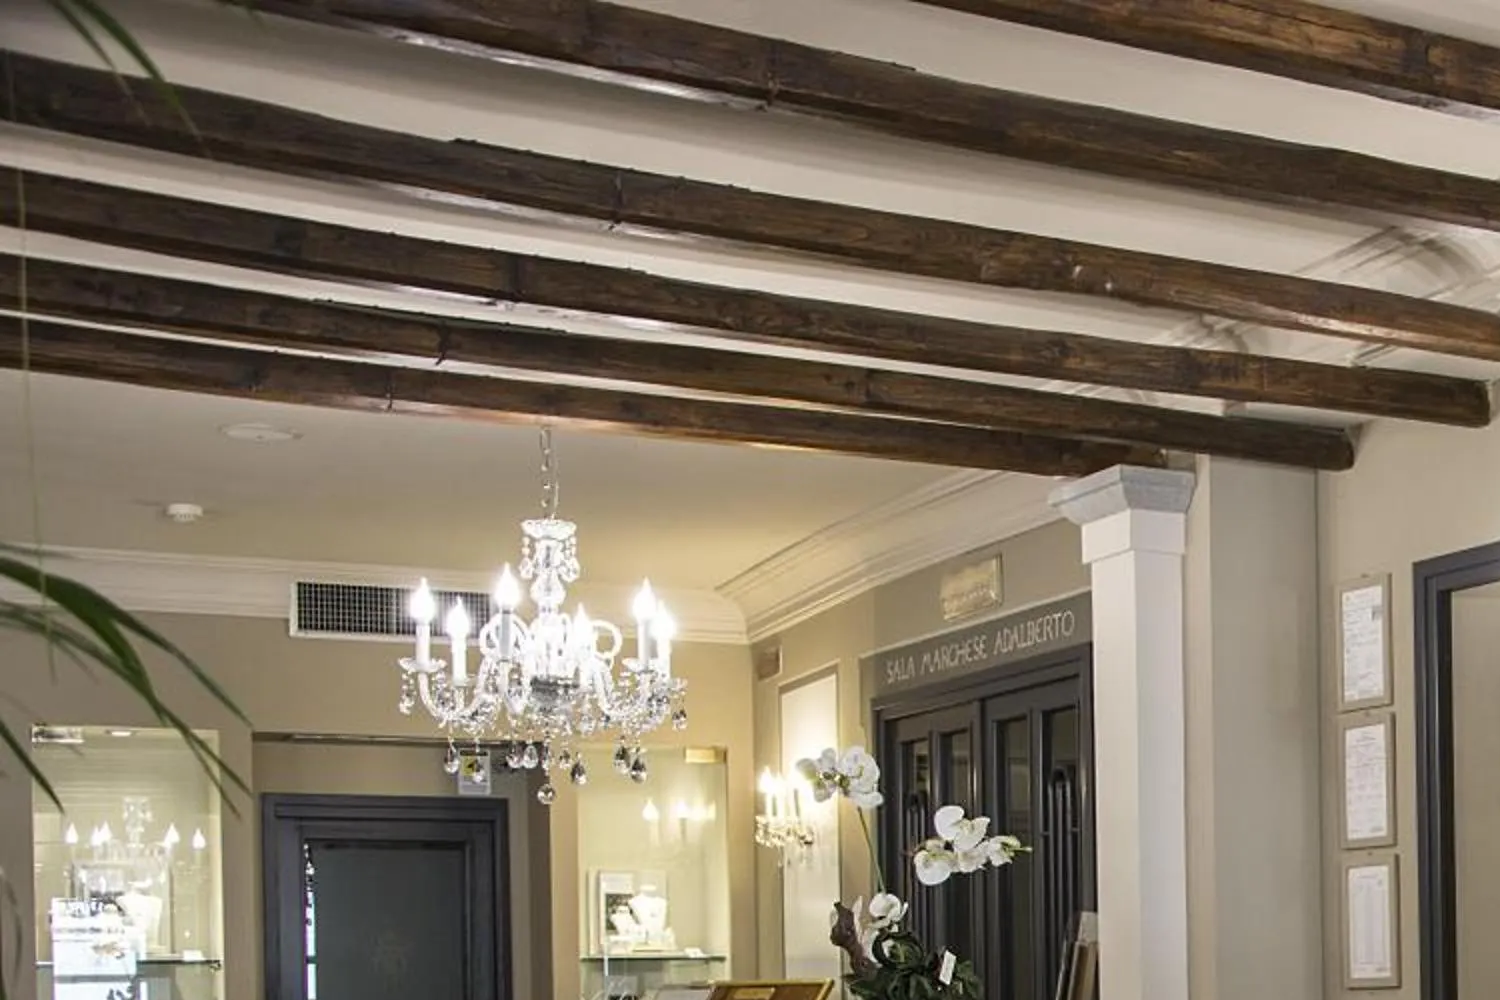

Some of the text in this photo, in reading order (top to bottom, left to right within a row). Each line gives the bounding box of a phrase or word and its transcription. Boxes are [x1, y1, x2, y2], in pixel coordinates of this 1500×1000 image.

[885, 609, 1076, 684] SALA MARCHESE ADALBERTO
